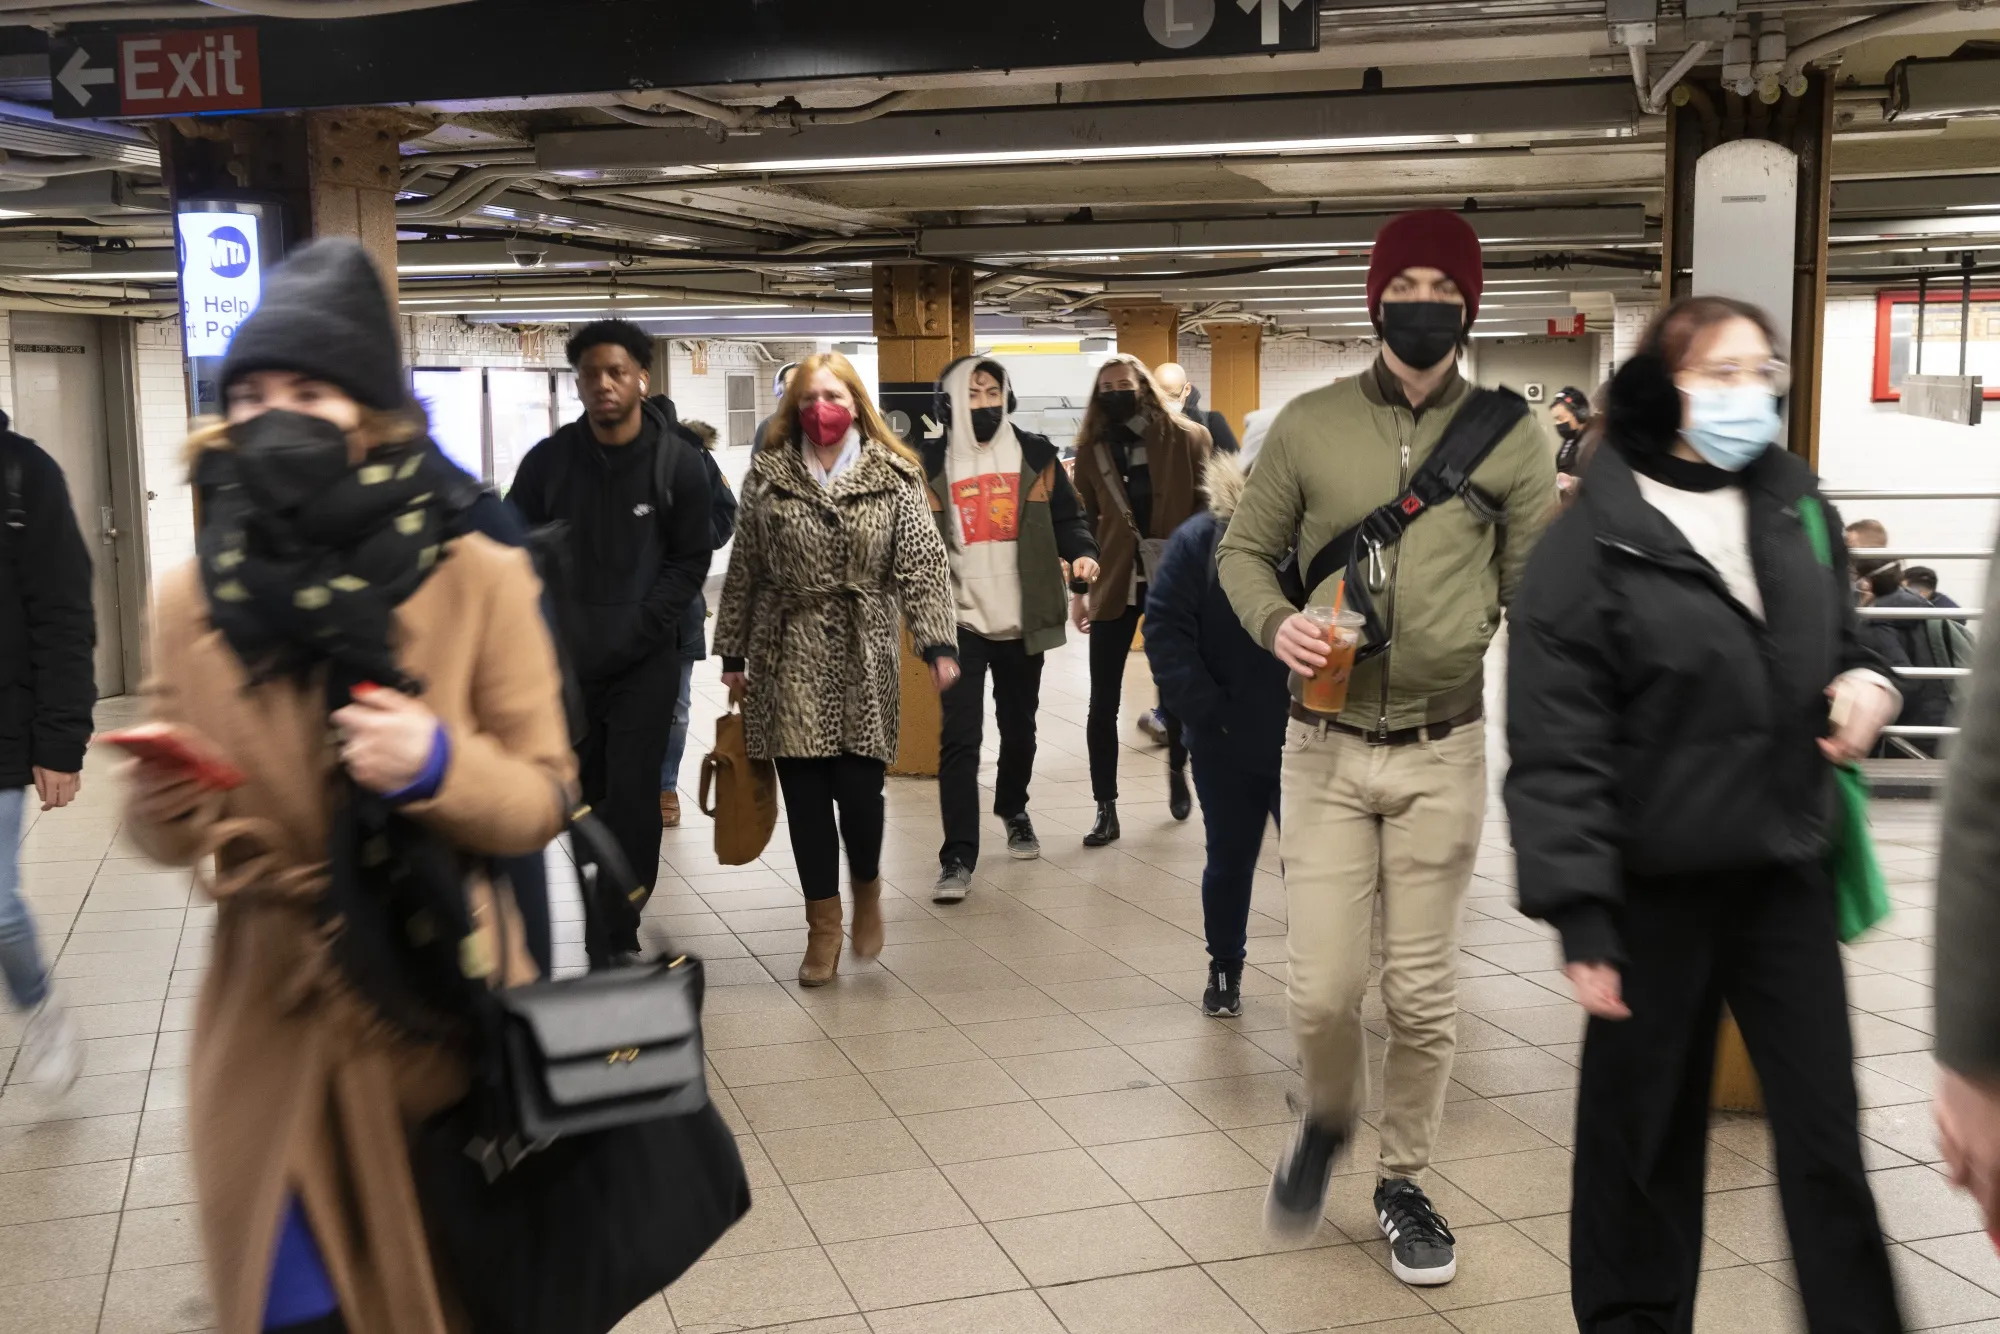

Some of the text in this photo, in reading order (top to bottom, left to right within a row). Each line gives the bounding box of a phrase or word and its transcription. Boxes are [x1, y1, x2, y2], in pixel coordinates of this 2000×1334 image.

[1165, 0, 1194, 38] L
[123, 35, 244, 100] Exit
[207, 236, 246, 268] MTA
[204, 296, 249, 318] Help
[526, 331, 542, 356] 14
[893, 416, 904, 433] L
